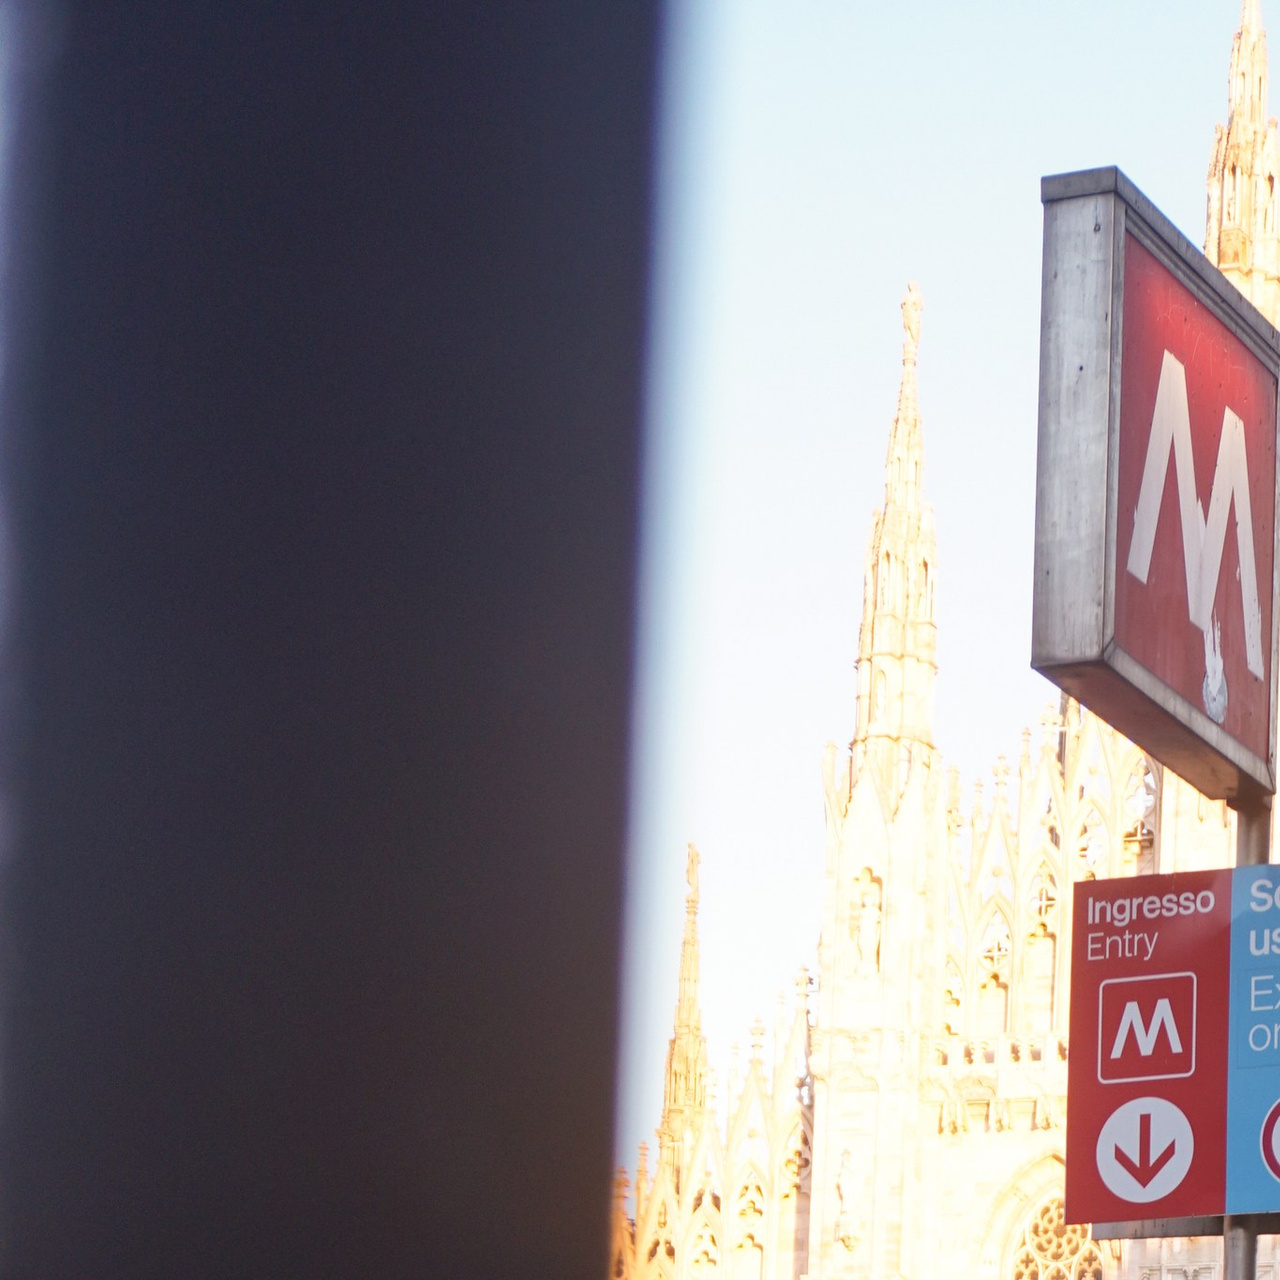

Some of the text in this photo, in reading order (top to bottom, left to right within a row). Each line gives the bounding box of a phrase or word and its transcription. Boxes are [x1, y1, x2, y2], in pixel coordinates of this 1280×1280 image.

[1126, 348, 1264, 682] M
[1087, 890, 1215, 927] Ingresso
[1087, 930, 1159, 961] Entry
[1110, 998, 1183, 1060] M
